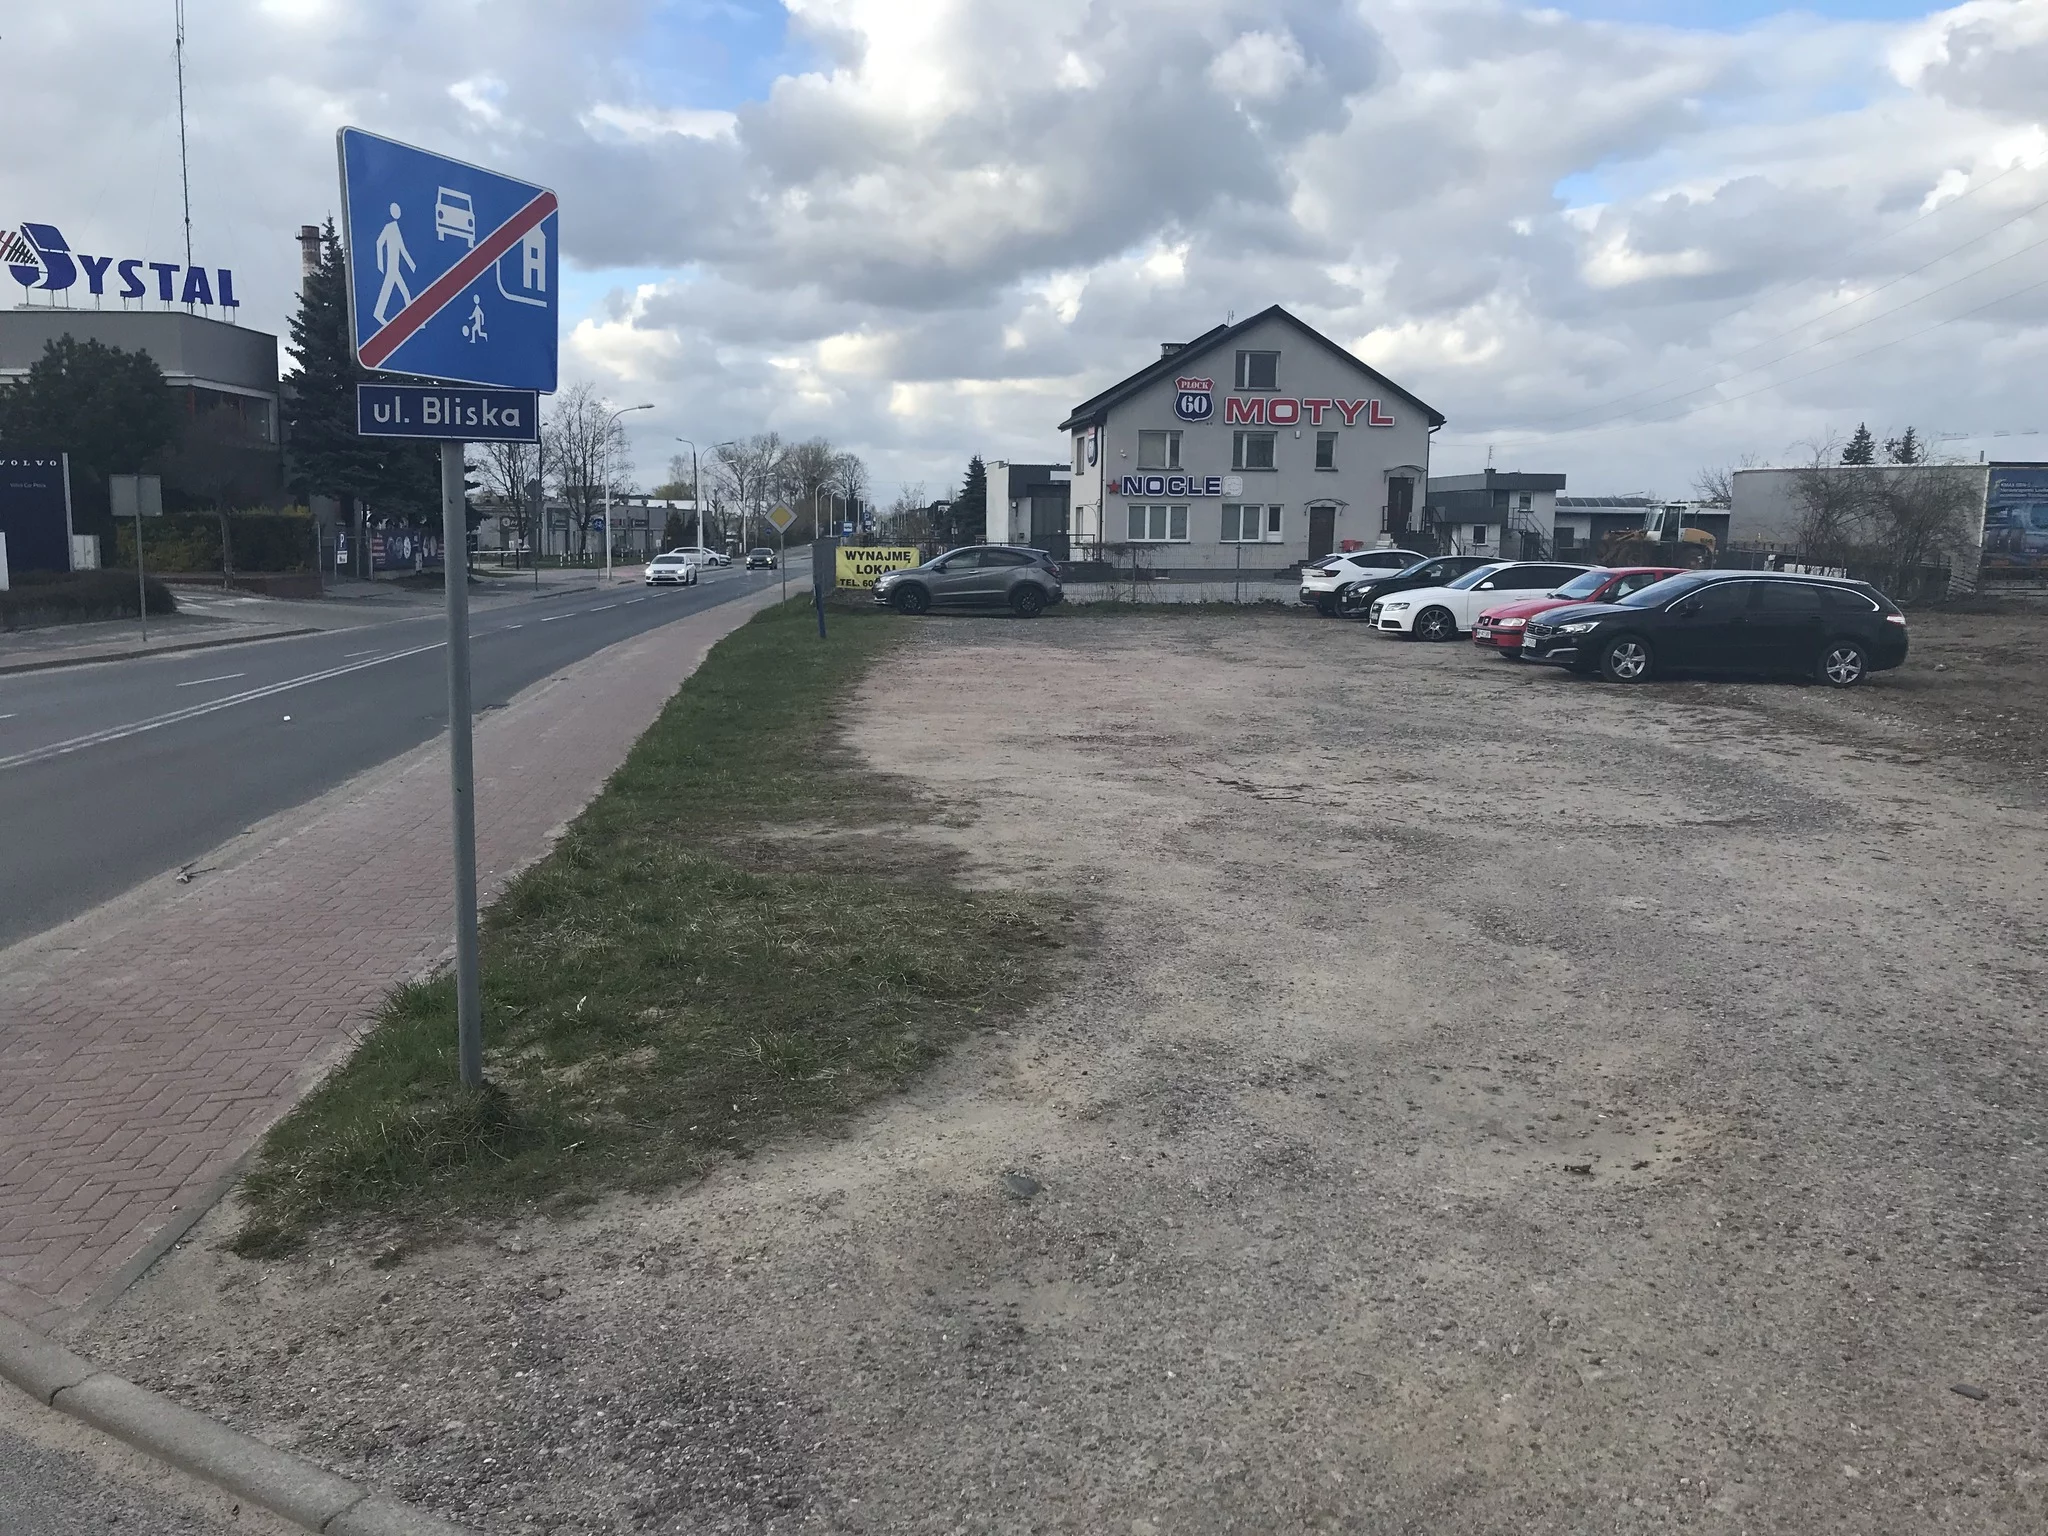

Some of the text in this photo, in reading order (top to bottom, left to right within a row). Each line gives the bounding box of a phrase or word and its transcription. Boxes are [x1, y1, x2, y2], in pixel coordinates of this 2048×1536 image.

[373, 396, 521, 427] ul. Bliska
[1181, 395, 1207, 413] 60
[1224, 397, 1395, 426] MOTYL
[845, 551, 911, 563] WYNAJMĘ
[840, 579, 860, 587] TEL.
